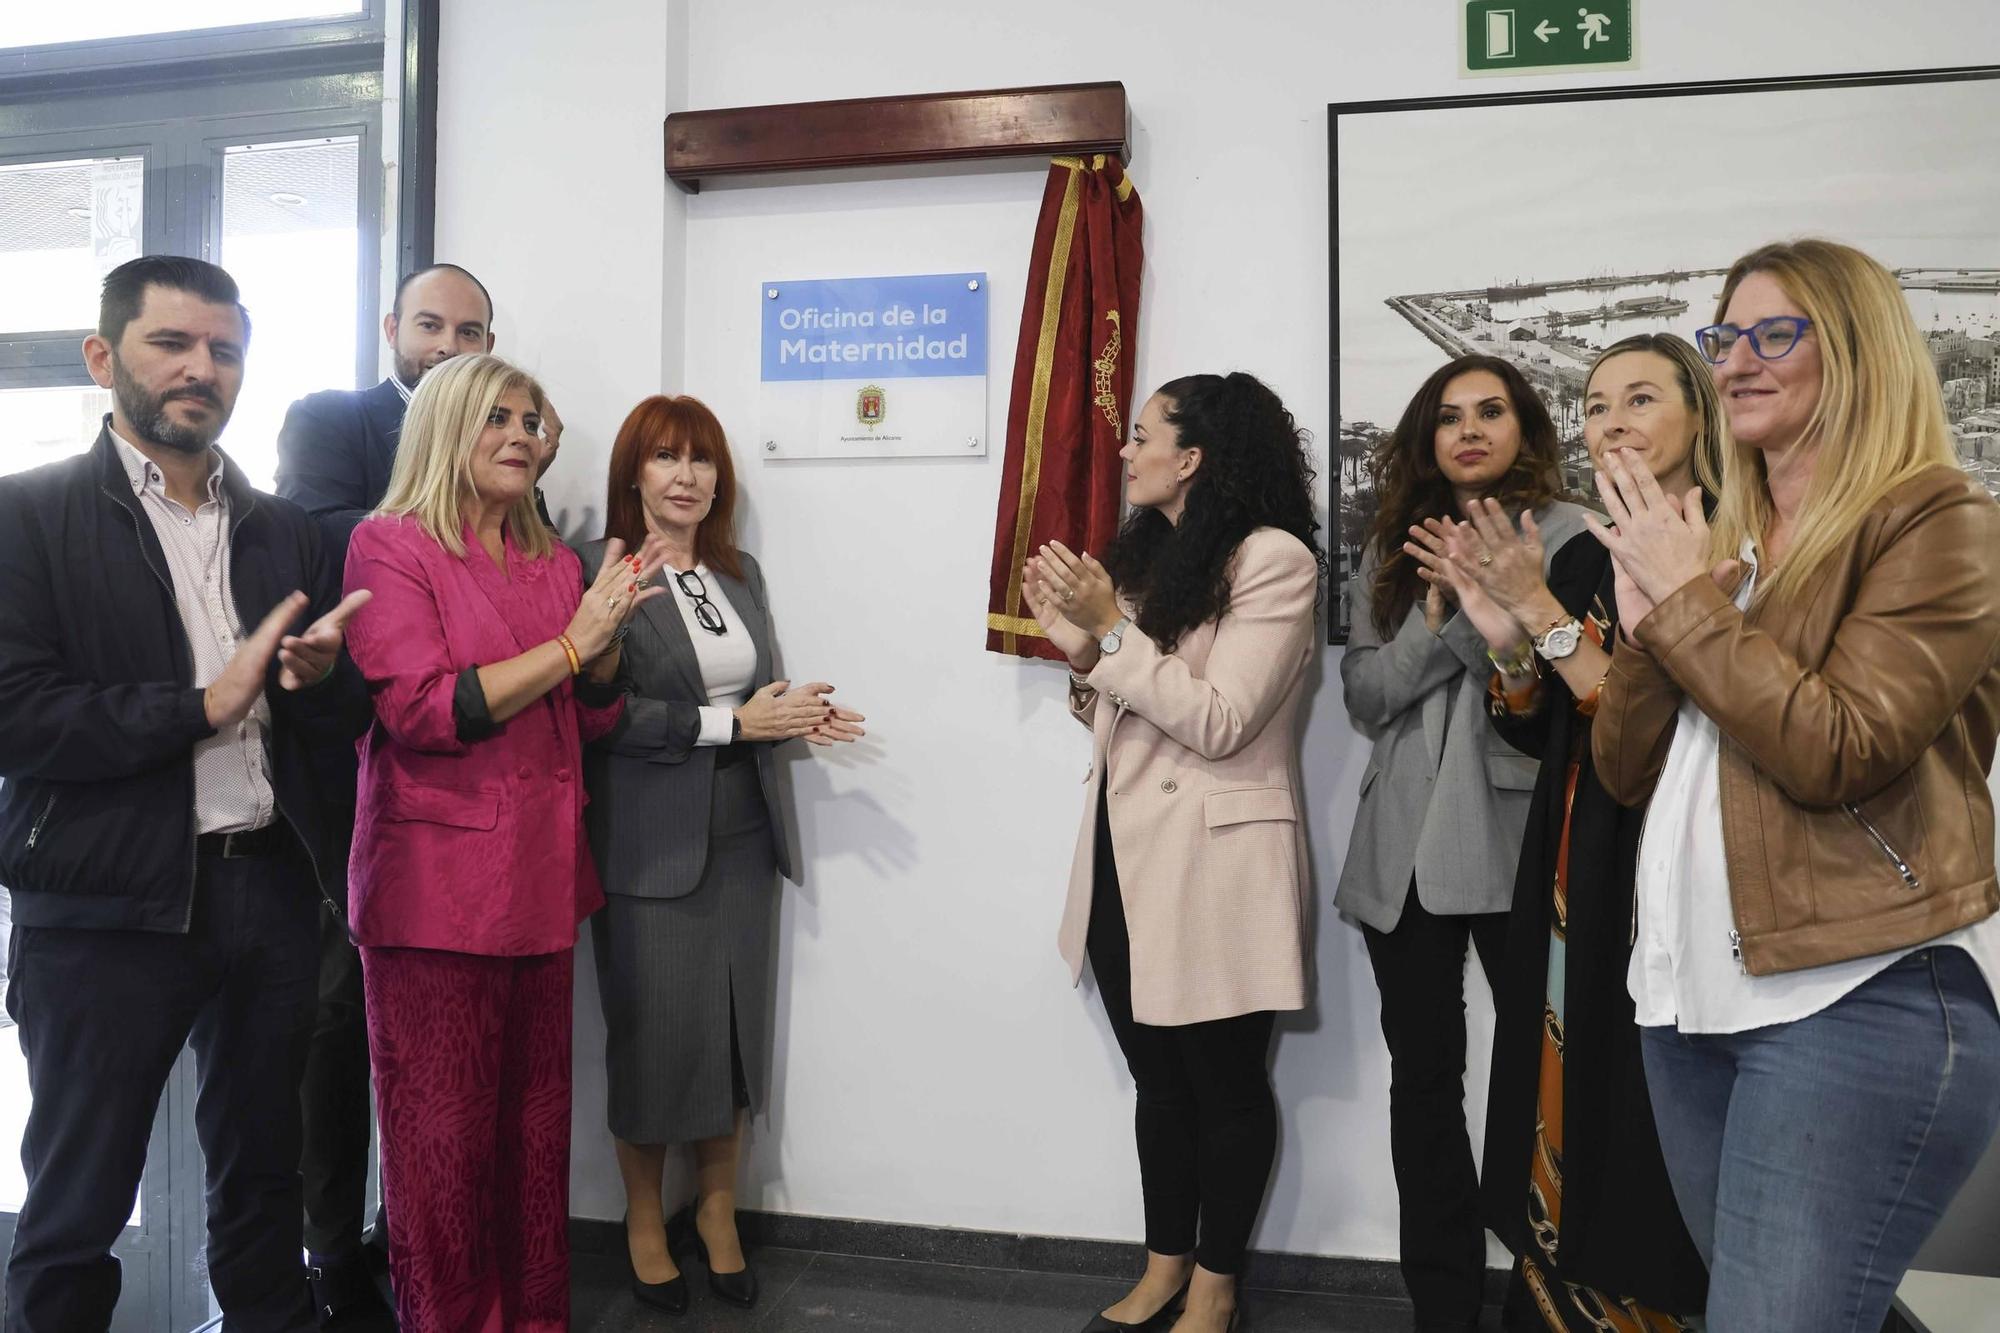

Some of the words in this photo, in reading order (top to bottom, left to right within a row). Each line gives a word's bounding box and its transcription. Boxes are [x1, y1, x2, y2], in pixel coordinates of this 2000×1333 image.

[779, 307, 874, 330] Oficina
[882, 304, 915, 327] de
[923, 304, 947, 325] la
[780, 333, 968, 365] Maternidad
